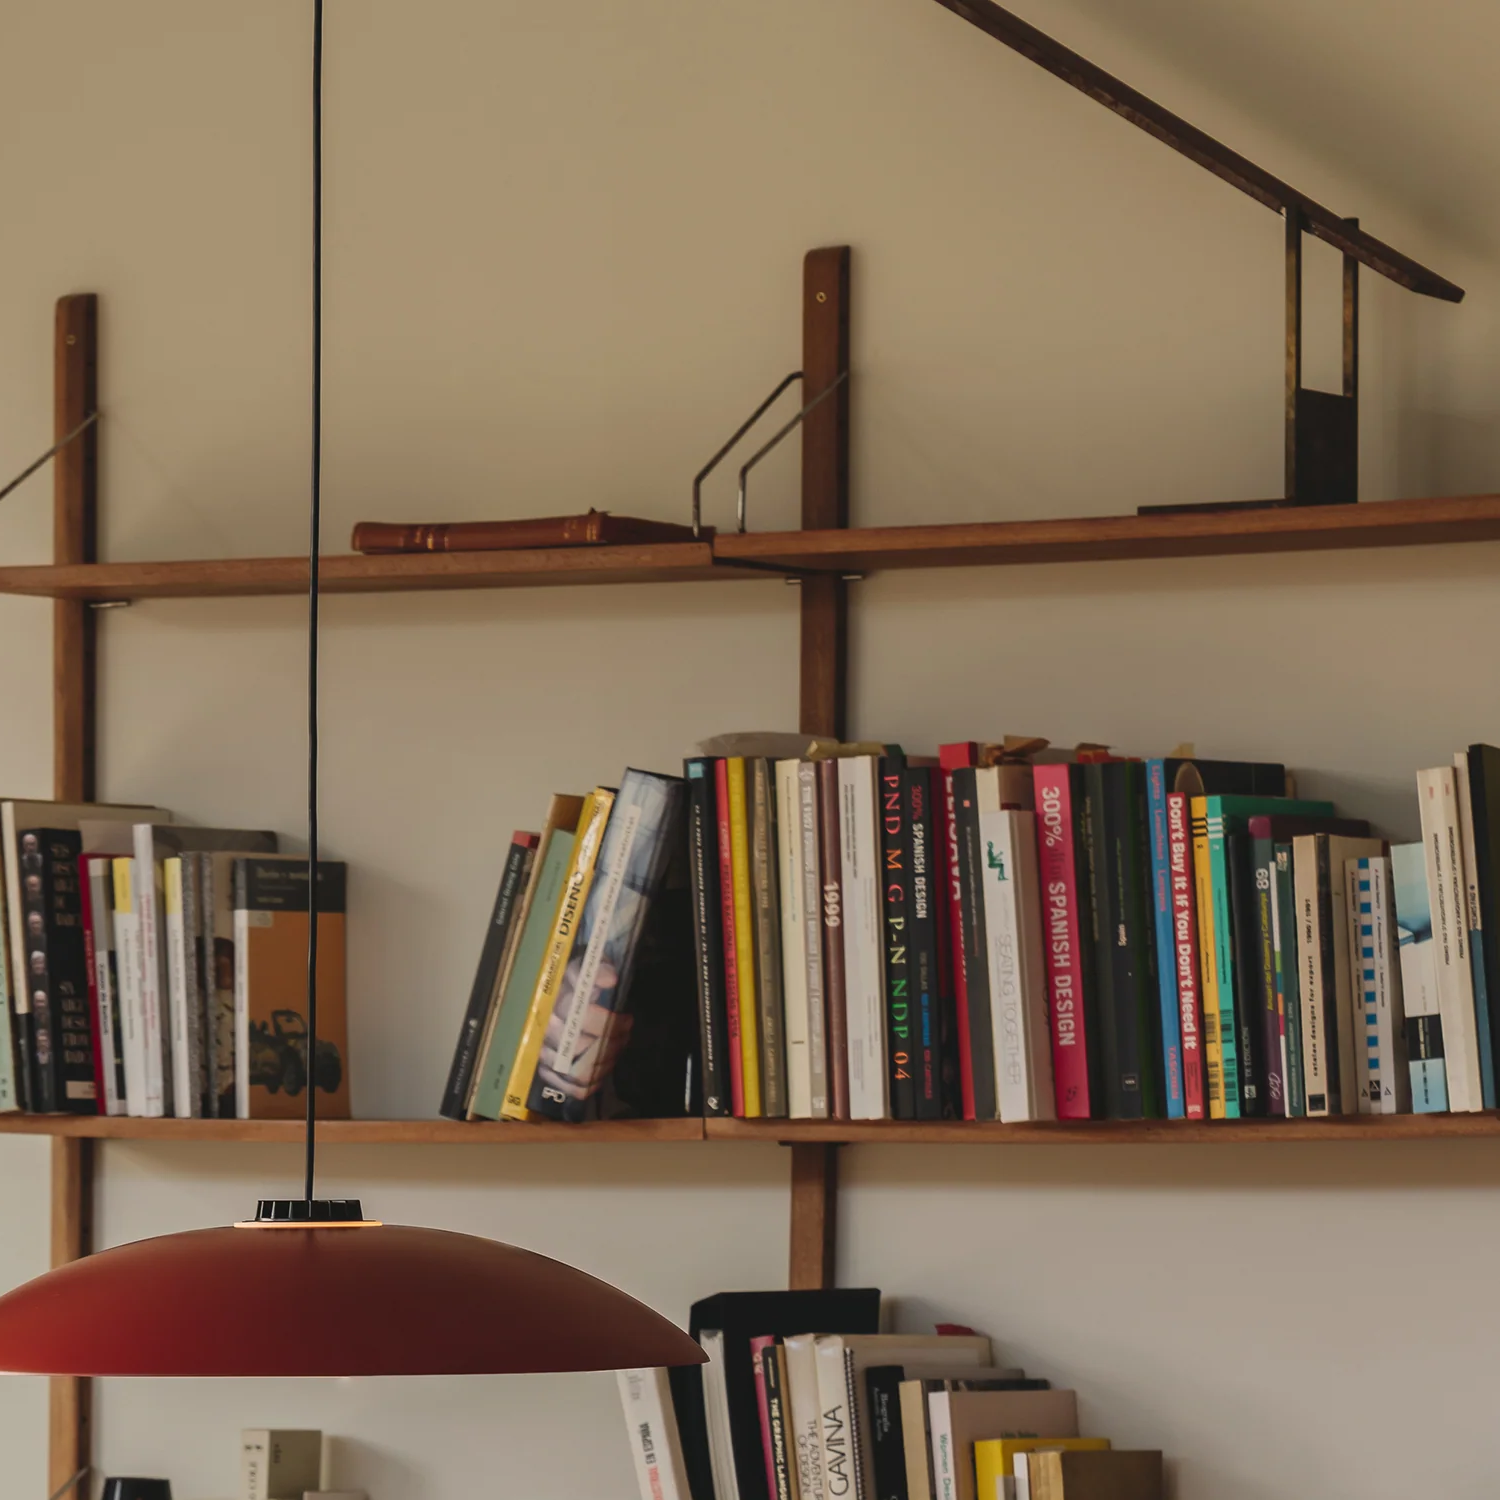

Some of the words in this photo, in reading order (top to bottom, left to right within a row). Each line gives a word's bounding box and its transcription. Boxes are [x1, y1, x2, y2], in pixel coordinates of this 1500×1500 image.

[911, 785, 923, 819] 300%
[1151, 764, 1162, 800] Lights
[883, 775, 902, 834] PND
[1041, 786, 1062, 847] 300%
[1169, 796, 1186, 840] Don't
[886, 848, 902, 869] M
[912, 823, 927, 873] SPANISH
[1170, 842, 1186, 873] Buy
[887, 884, 903, 903] G
[914, 877, 927, 919] DESIGN
[1174, 876, 1188, 890] It
[1255, 868, 1269, 890] 89
[824, 882, 840, 927] 1999
[1175, 894, 1189, 908] If
[889, 917, 906, 964] P-N
[1048, 882, 1070, 967] SPANISH
[1176, 910, 1191, 941] You
[1178, 944, 1193, 988] Don't
[891, 979, 909, 1040] NDP
[1055, 975, 1076, 1046] DESIGN
[1181, 991, 1196, 1032] Need
[1183, 1036, 1197, 1050] It
[894, 1051, 911, 1080] 04
[769, 1398, 780, 1417] THE
[771, 1419, 784, 1464] GRAPHIC
[797, 1435, 809, 1450] OF
[806, 1419, 818, 1440] THE
[823, 1405, 850, 1496] GAVINA
[939, 1434, 950, 1474] Women
